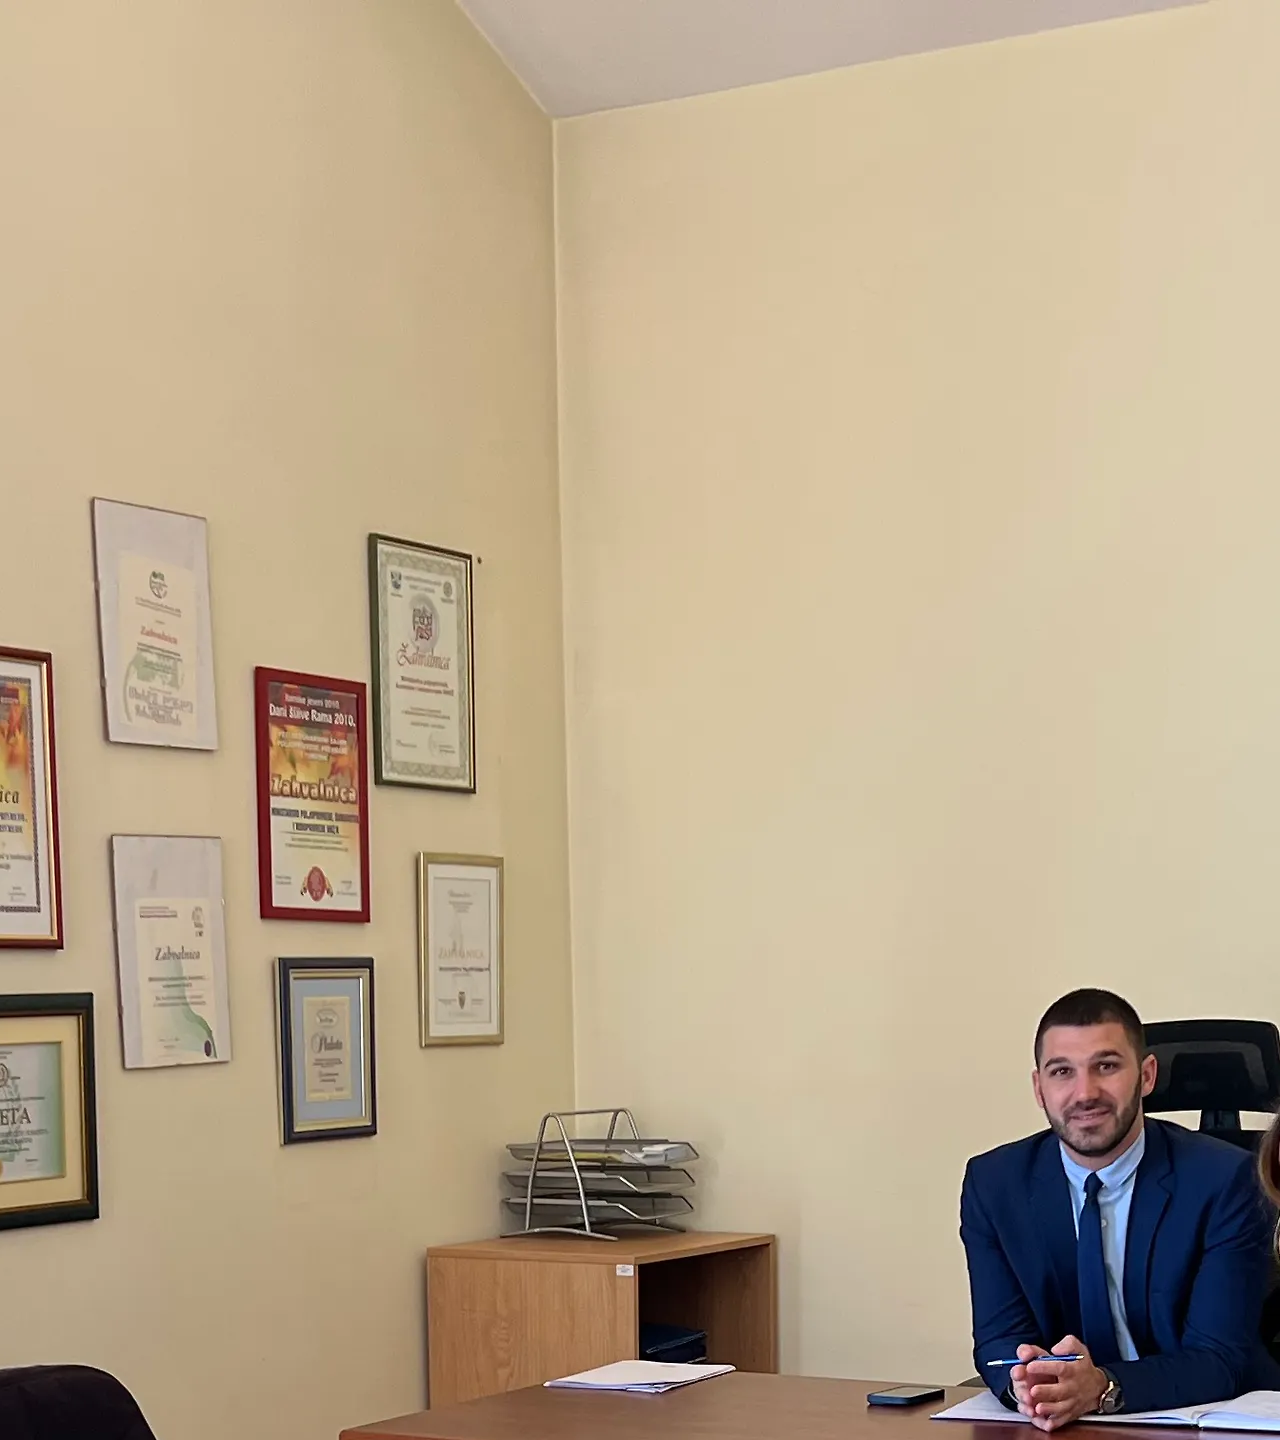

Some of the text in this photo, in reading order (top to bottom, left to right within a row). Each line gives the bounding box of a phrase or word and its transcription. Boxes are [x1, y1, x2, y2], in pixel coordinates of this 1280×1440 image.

[269, 703, 288, 717] Dani
[310, 709, 333, 724] Rama
[334, 712, 356, 728] 2010.
[270, 774, 357, 804] Zahvalnica
